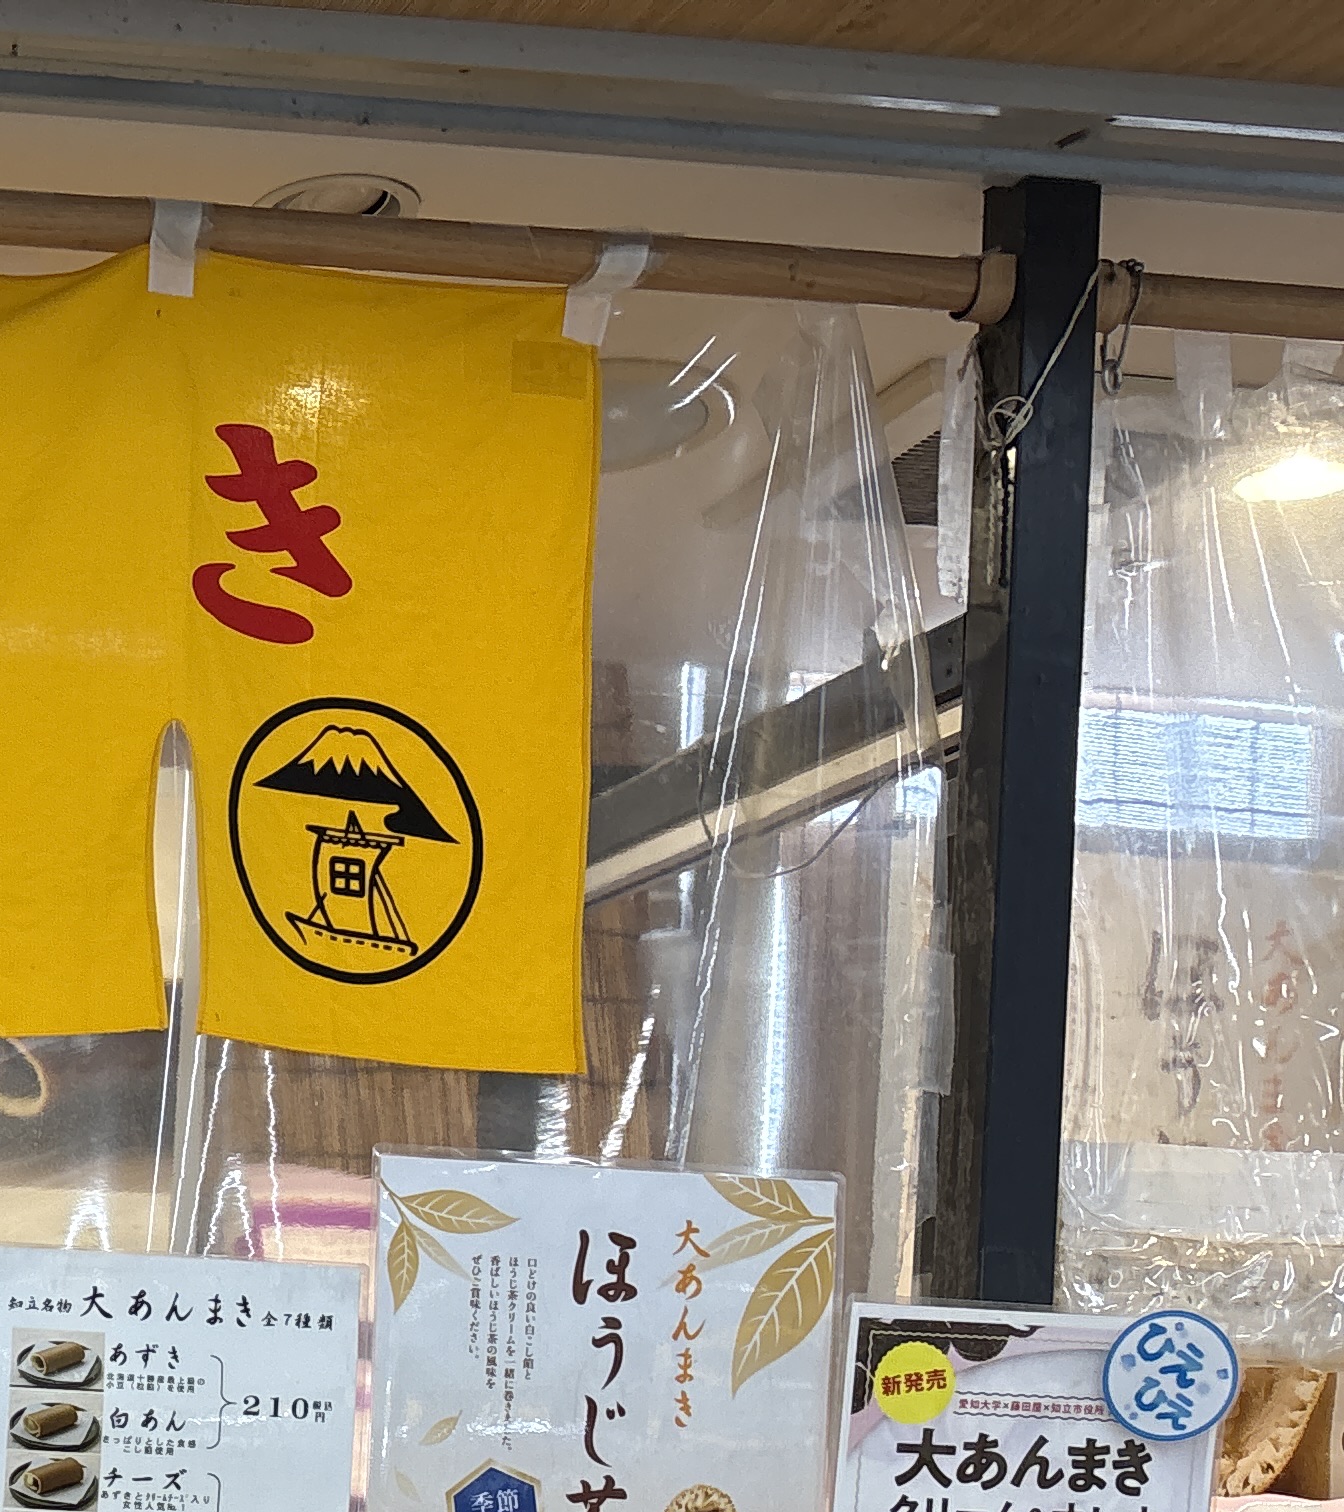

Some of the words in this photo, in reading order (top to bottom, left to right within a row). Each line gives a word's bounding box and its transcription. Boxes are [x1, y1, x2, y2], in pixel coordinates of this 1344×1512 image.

[7, 1295, 73, 1314] 知立名物
[80, 1285, 252, 1329] 大あんまき
[671, 1218, 711, 1428] 大あんまき
[109, 1342, 181, 1370] あずき
[880, 1367, 949, 1398] 新発売
[109, 1406, 187, 1432] 白あん
[243, 1395, 309, 1420] 210
[893, 1427, 1153, 1496] 大あんまき
[103, 1467, 188, 1491] チーズ
